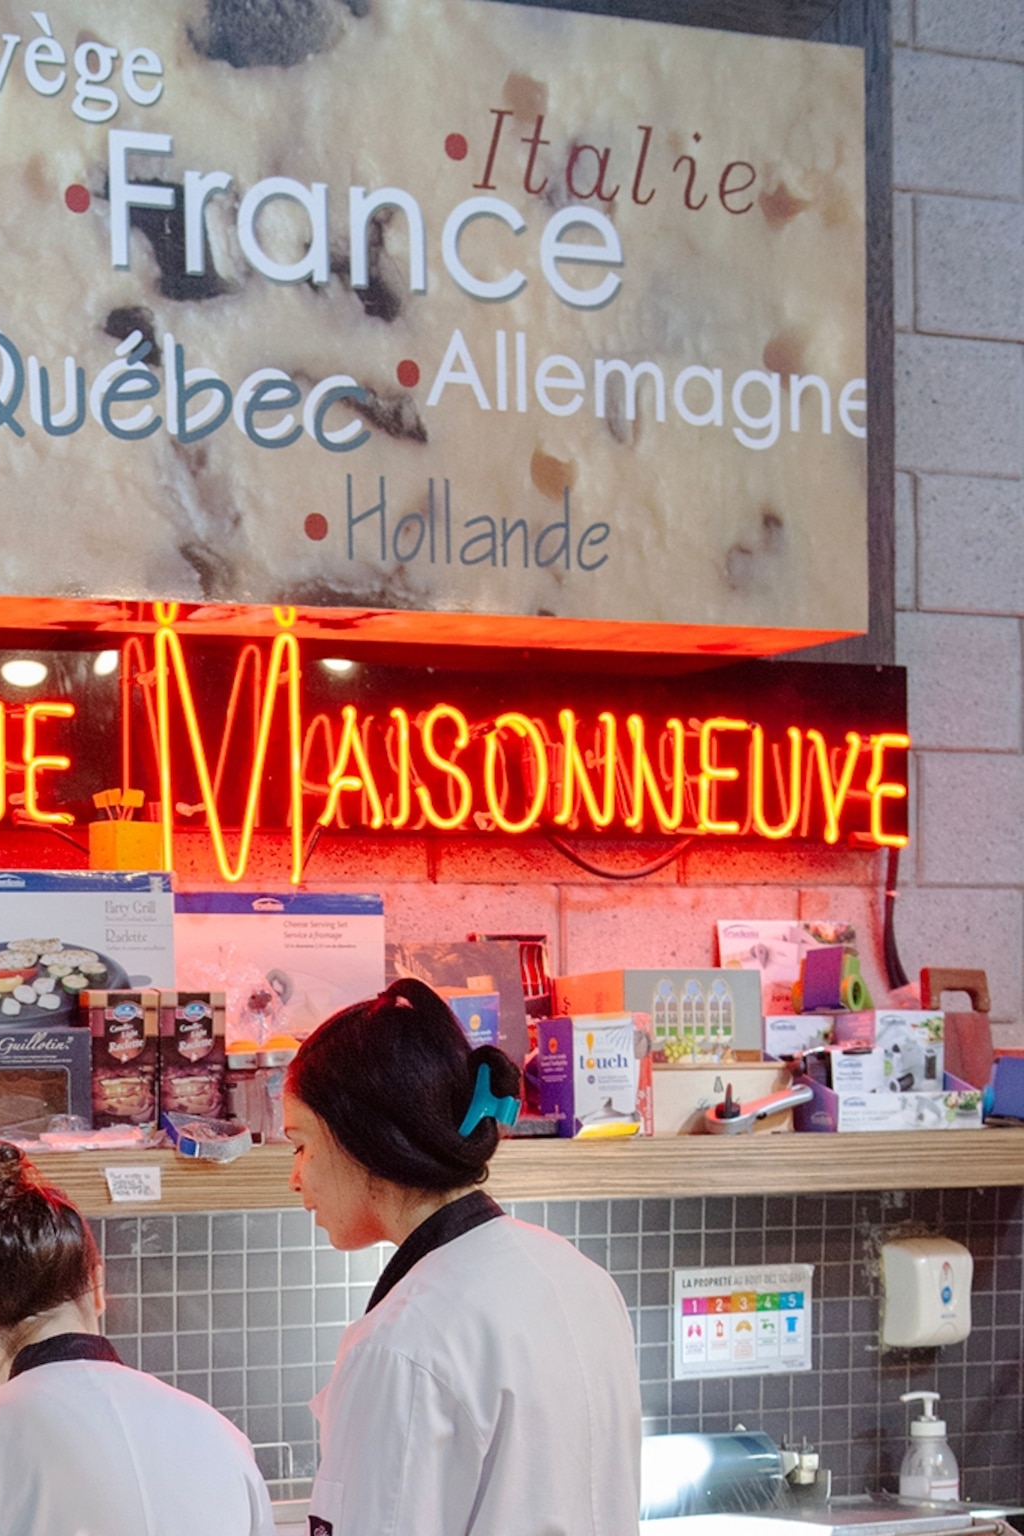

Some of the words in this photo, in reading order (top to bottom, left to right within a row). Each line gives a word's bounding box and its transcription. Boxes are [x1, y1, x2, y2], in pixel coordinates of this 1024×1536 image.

[108, 128, 625, 309] France
[473, 108, 759, 215] Italie
[425, 328, 867, 451] Allemagne
[345, 473, 611, 572] Hollande
[154, 623, 913, 884] MAISONNEUVE
[692, 1299, 698, 1313] 1
[716, 1298, 724, 1312] 2
[740, 1297, 748, 1311] 3
[764, 1296, 773, 1308] 4
[788, 1294, 797, 1308] 5
